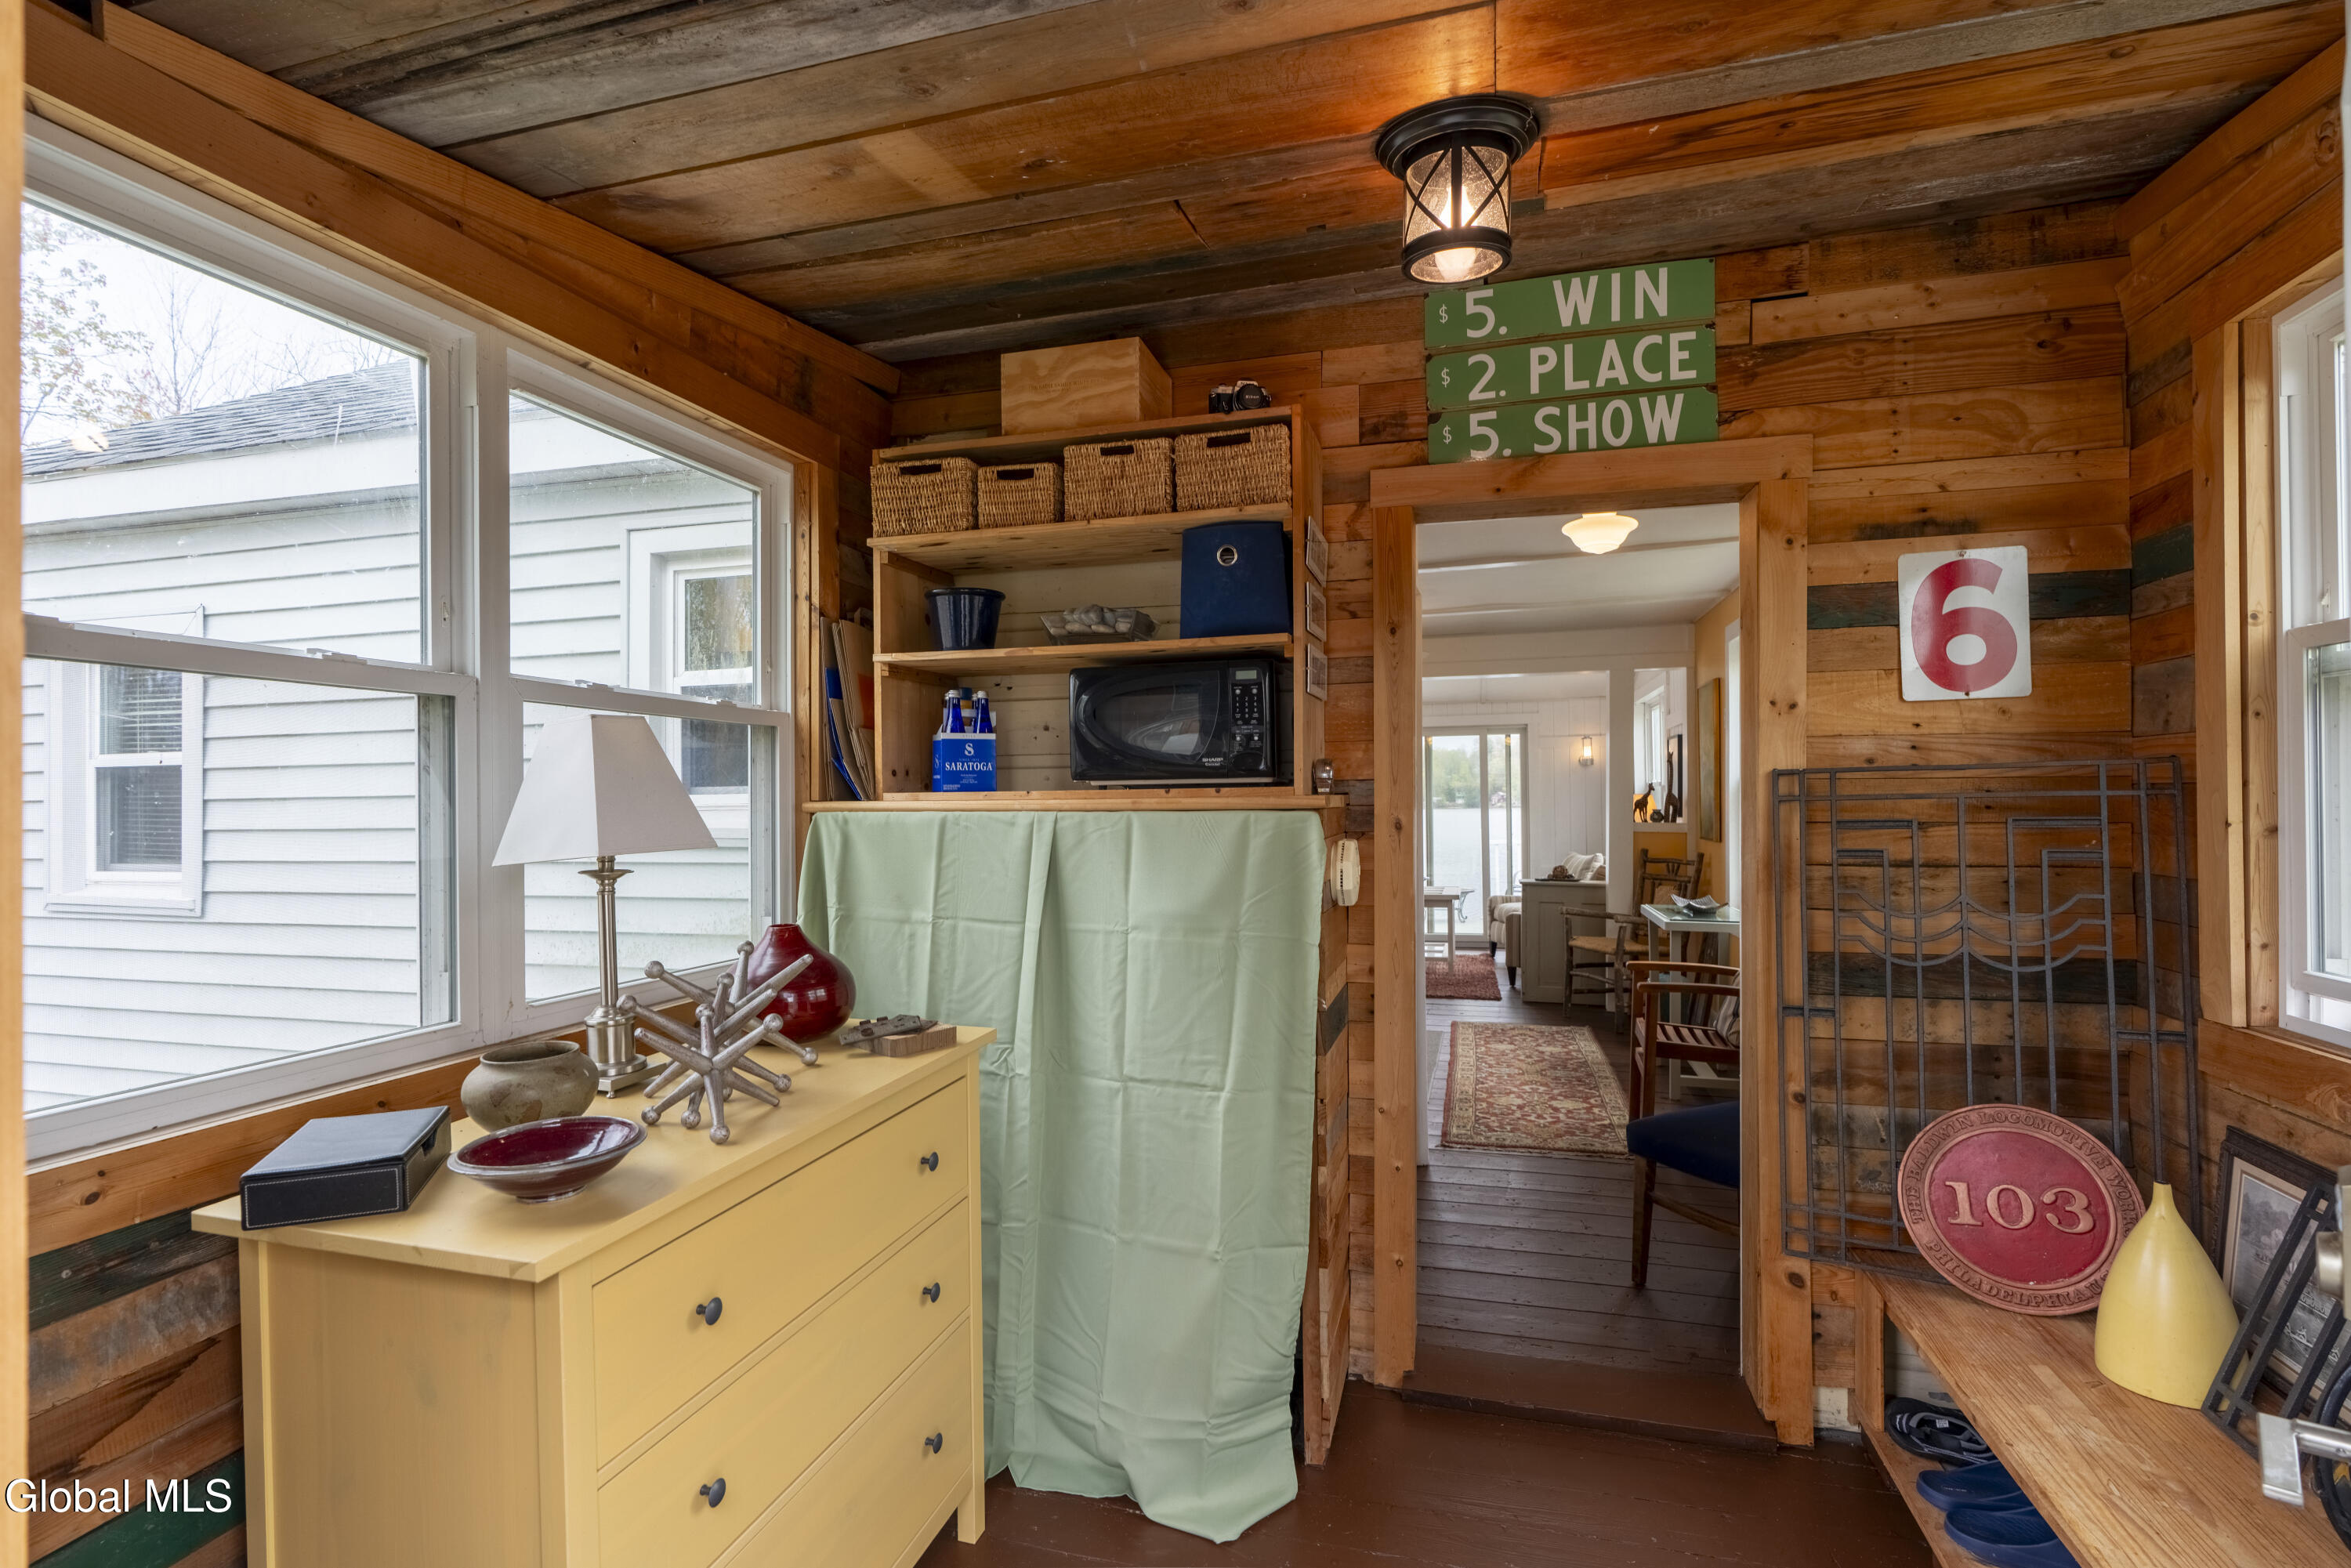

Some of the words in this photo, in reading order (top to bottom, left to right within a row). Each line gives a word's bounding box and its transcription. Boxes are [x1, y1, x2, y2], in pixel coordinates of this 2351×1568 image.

[1439, 303, 1448, 324] $
[1465, 288, 1508, 339] 5.
[1552, 267, 1668, 328] WIN
[1440, 367, 1451, 387] $
[1468, 353, 1506, 401] 2.
[1530, 331, 1697, 395] PLACE
[1442, 425, 1452, 444] $
[1469, 410, 1512, 459] 5.
[1534, 393, 1684, 454] SHOW
[1911, 558, 2018, 693] 6
[945, 762, 993, 771] SARATOGA
[965, 742, 974, 756] S
[1907, 1114, 1974, 1181] BALDWIN
[1979, 1110, 2113, 1170] LOCOMOTIVE
[1906, 1184, 1925, 1224] THE
[1944, 1182, 2096, 1234] 103
